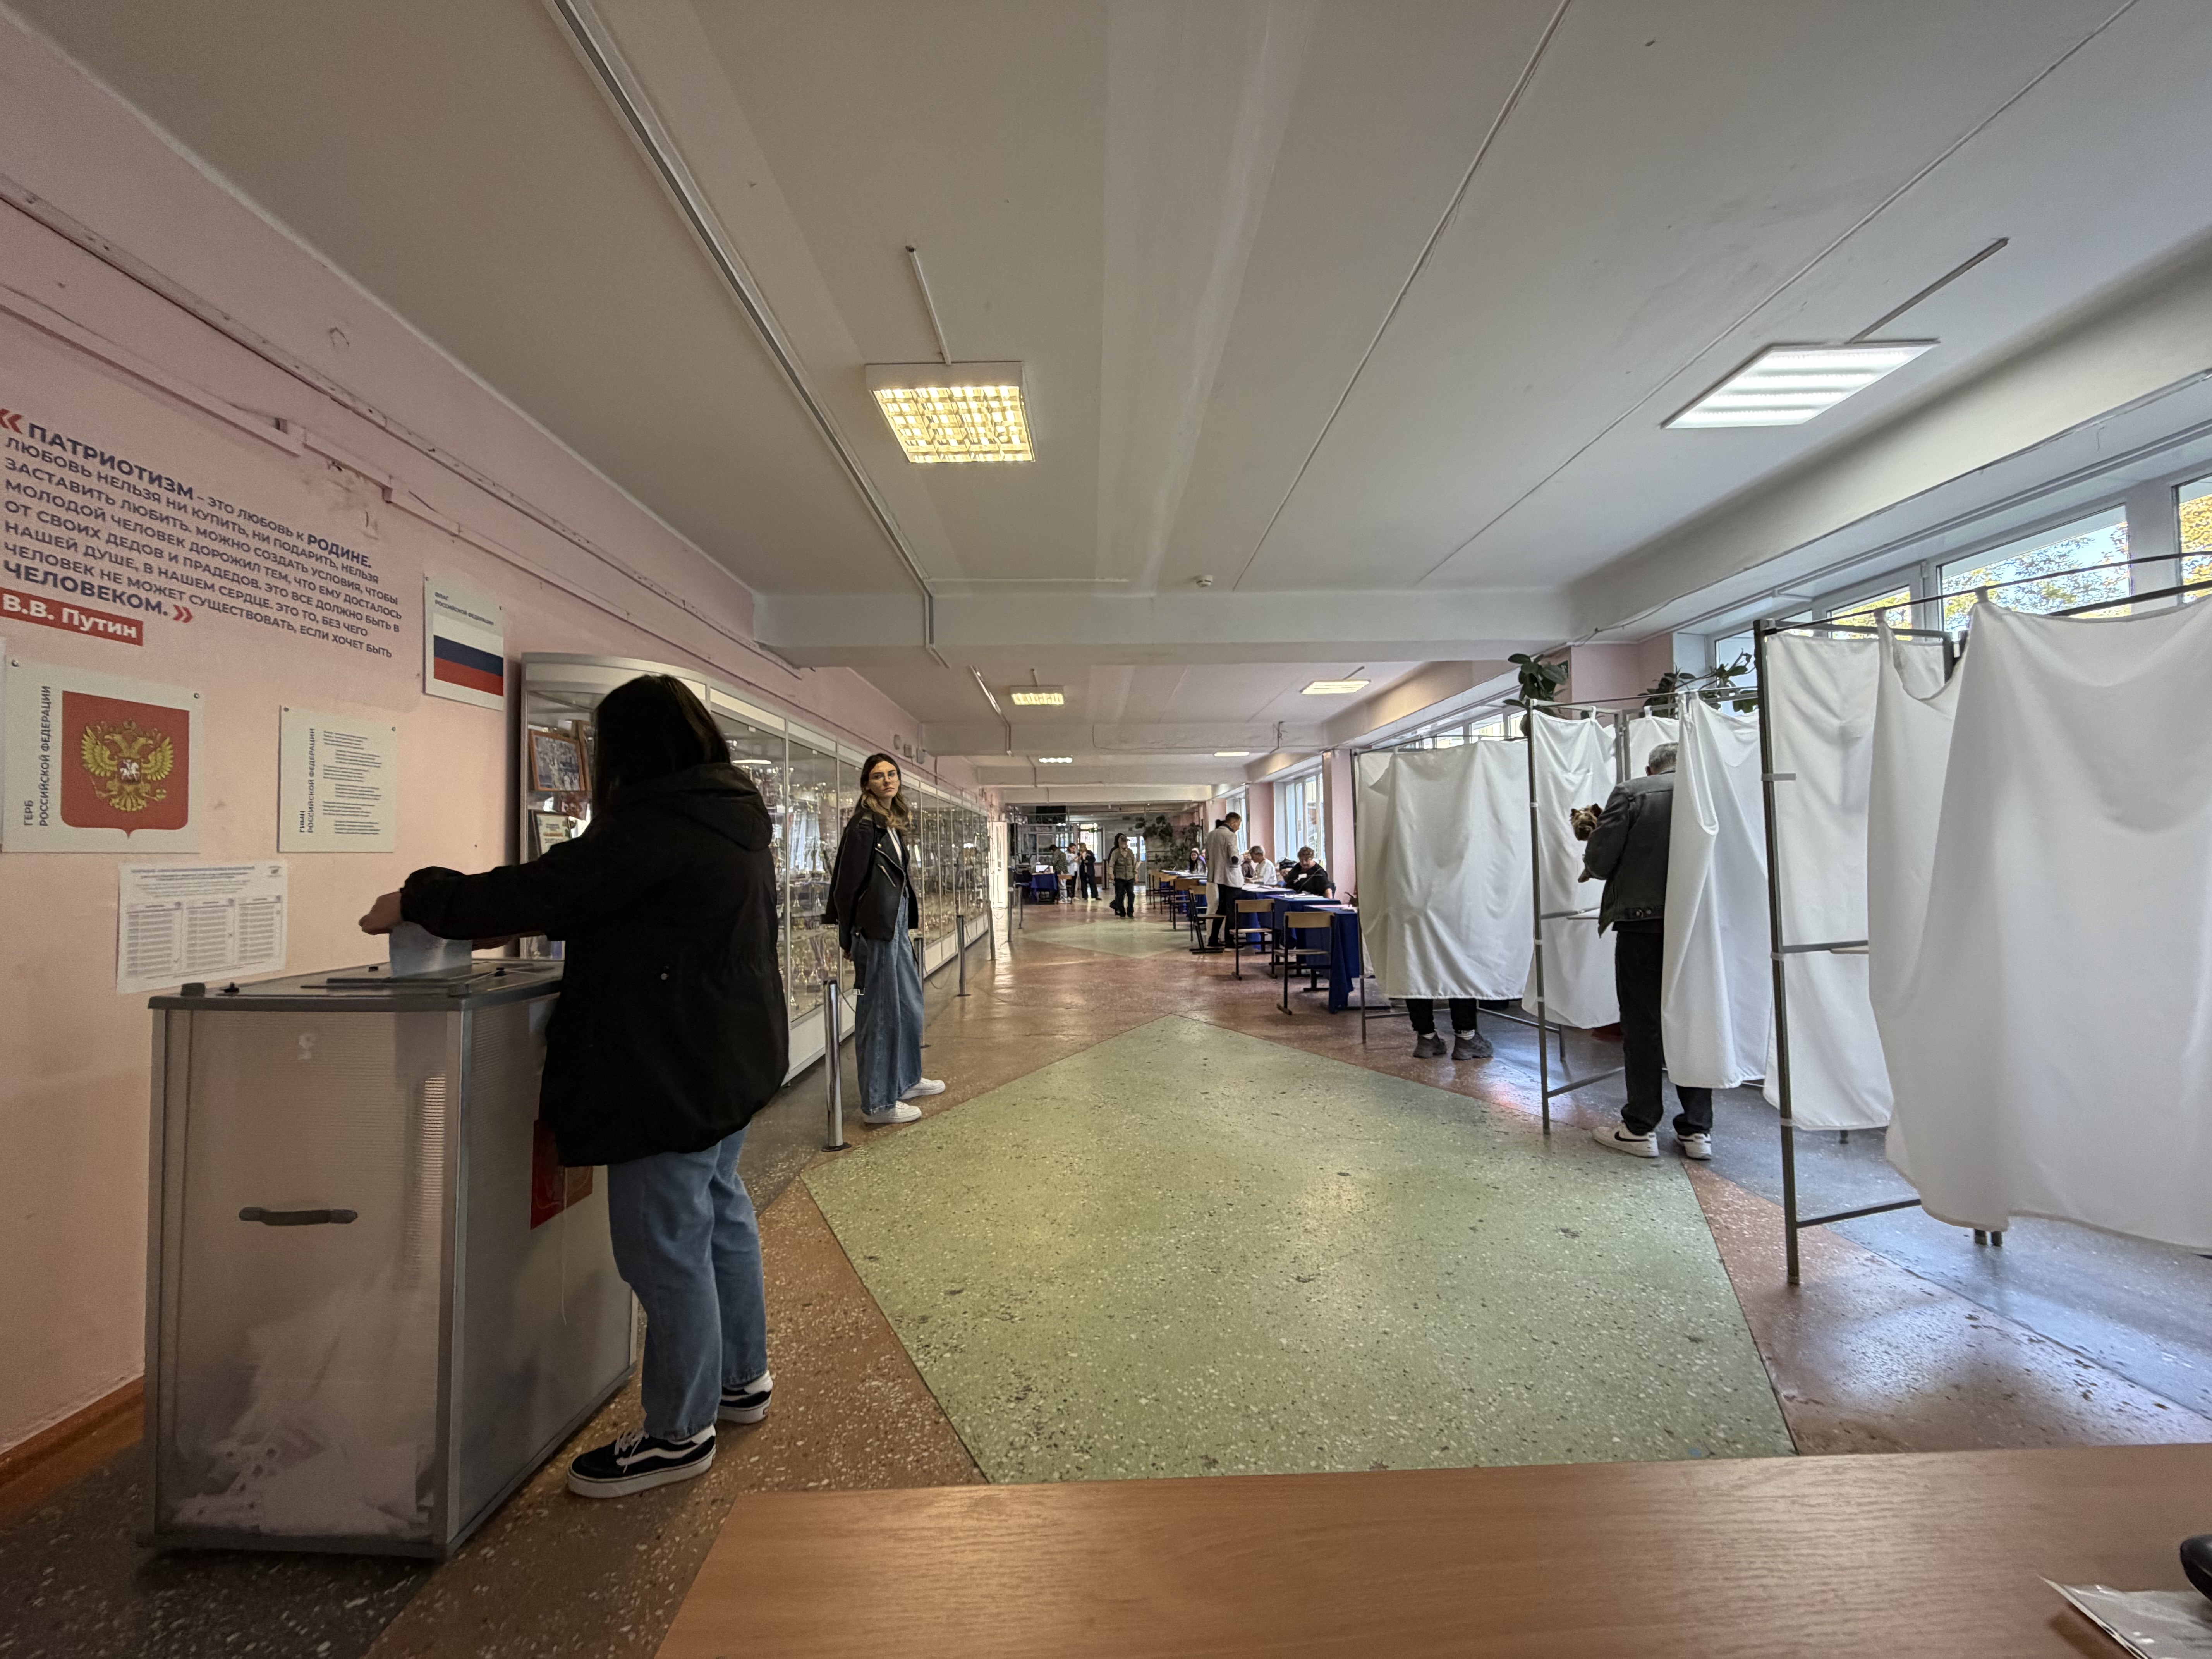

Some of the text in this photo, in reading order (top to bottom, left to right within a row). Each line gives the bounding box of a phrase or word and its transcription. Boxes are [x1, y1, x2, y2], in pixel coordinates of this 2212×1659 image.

[5, 437, 378, 584] ЛЮБОВЬ НЕЛЬЗЯ НИ КУПИТЬ, НИ ПОДАРИТЬ, НЕЛЬЗЯ
[5, 457, 398, 605] ЗАСТАВИТЬ ЛЮБИТЬ. МОЖНО СОЗДАТЬ УСЛОВИЯ, ЧТОБЫ
[5, 500, 400, 632] ОТ СВОИХ ДЕДОВ И ПРАДЕДОВ. ЭТО ВСЕ ДОЛЖНО БЫТЬ В
[6, 479, 402, 620] МОЛОДОЙ ЧЕЛОВЕК ДОРОЖИЛ ТЕМ, ЧТО ЕМУ ДОСТАЛОСЬ
[208, 497, 234, 514] ЭТО
[238, 509, 293, 537] ЛЮБОВЬ
[297, 531, 304, 541] К
[307, 534, 372, 568] РОДИНЕ.
[3, 543, 392, 658] ЧЕЛОВЕК НЕ МОЖЕТ СУЩЕСТВОВАТЬ, ЕСЛИ ХОЧЕТ БЫТЬ
[3, 594, 137, 639] В.В. Путин
[5, 520, 78, 553] НАШЕЙ
[83, 545, 139, 570] ДУШЕ,
[143, 563, 153, 574] В
[158, 567, 215, 592] НАШЕМ
[276, 602, 299, 617] ЭТО
[302, 611, 319, 624] ТО,
[322, 617, 341, 629] БЕЗ
[343, 623, 368, 637] ЧЕГО
[23, 800, 34, 826] ГЕРБ
[39, 686, 51, 826] РОССИЙСКОЙ ФЕДЕРАЦИИ
